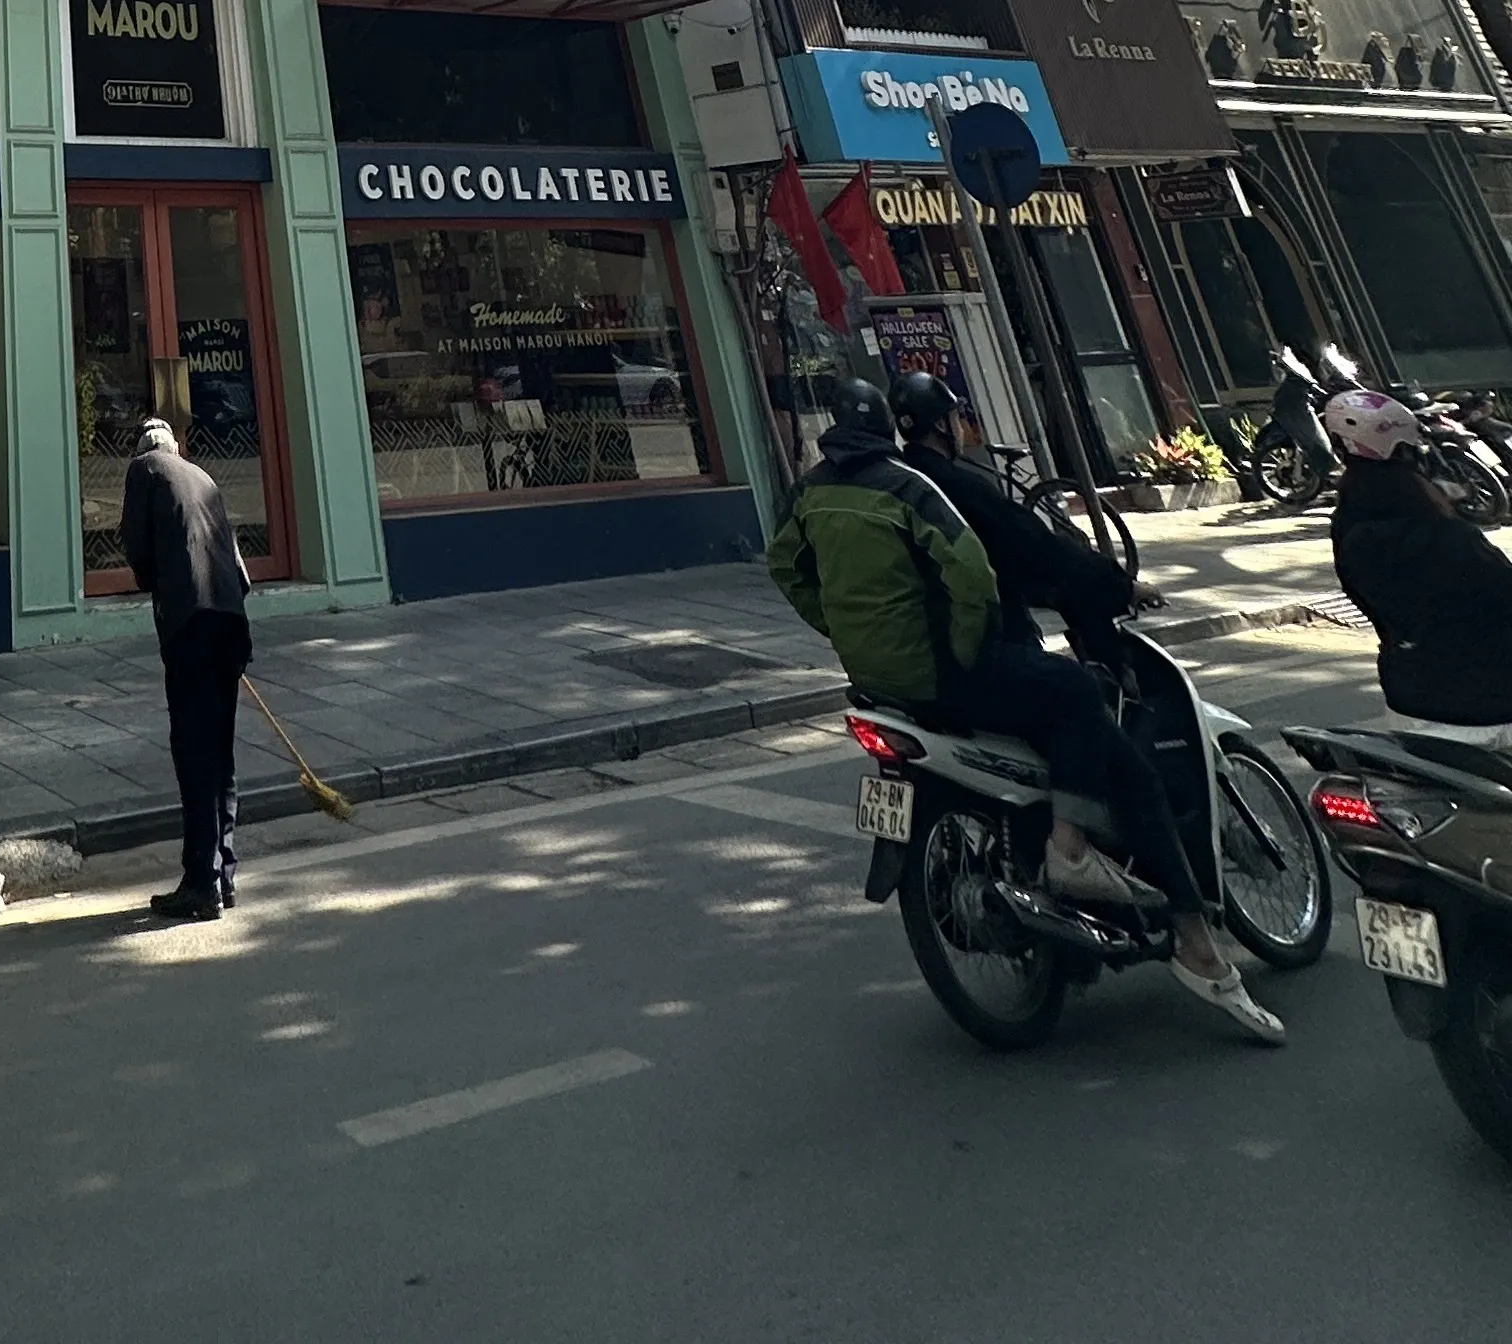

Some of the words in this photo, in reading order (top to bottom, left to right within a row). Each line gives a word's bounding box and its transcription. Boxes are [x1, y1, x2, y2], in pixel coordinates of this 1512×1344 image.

[1068, 36, 1095, 58] La
[1092, 37, 1156, 61] Renna
[358, 164, 673, 202] CHOCOLATERIE
[470, 301, 566, 329] Homemade
[186, 318, 241, 342] MAISON
[880, 321, 942, 334] HALLOWEEN
[438, 339, 454, 354] AT
[458, 336, 512, 353] MAISON
[516, 333, 564, 350] MAROU
[902, 336, 929, 349] SALE
[188, 349, 244, 373] MAROU
